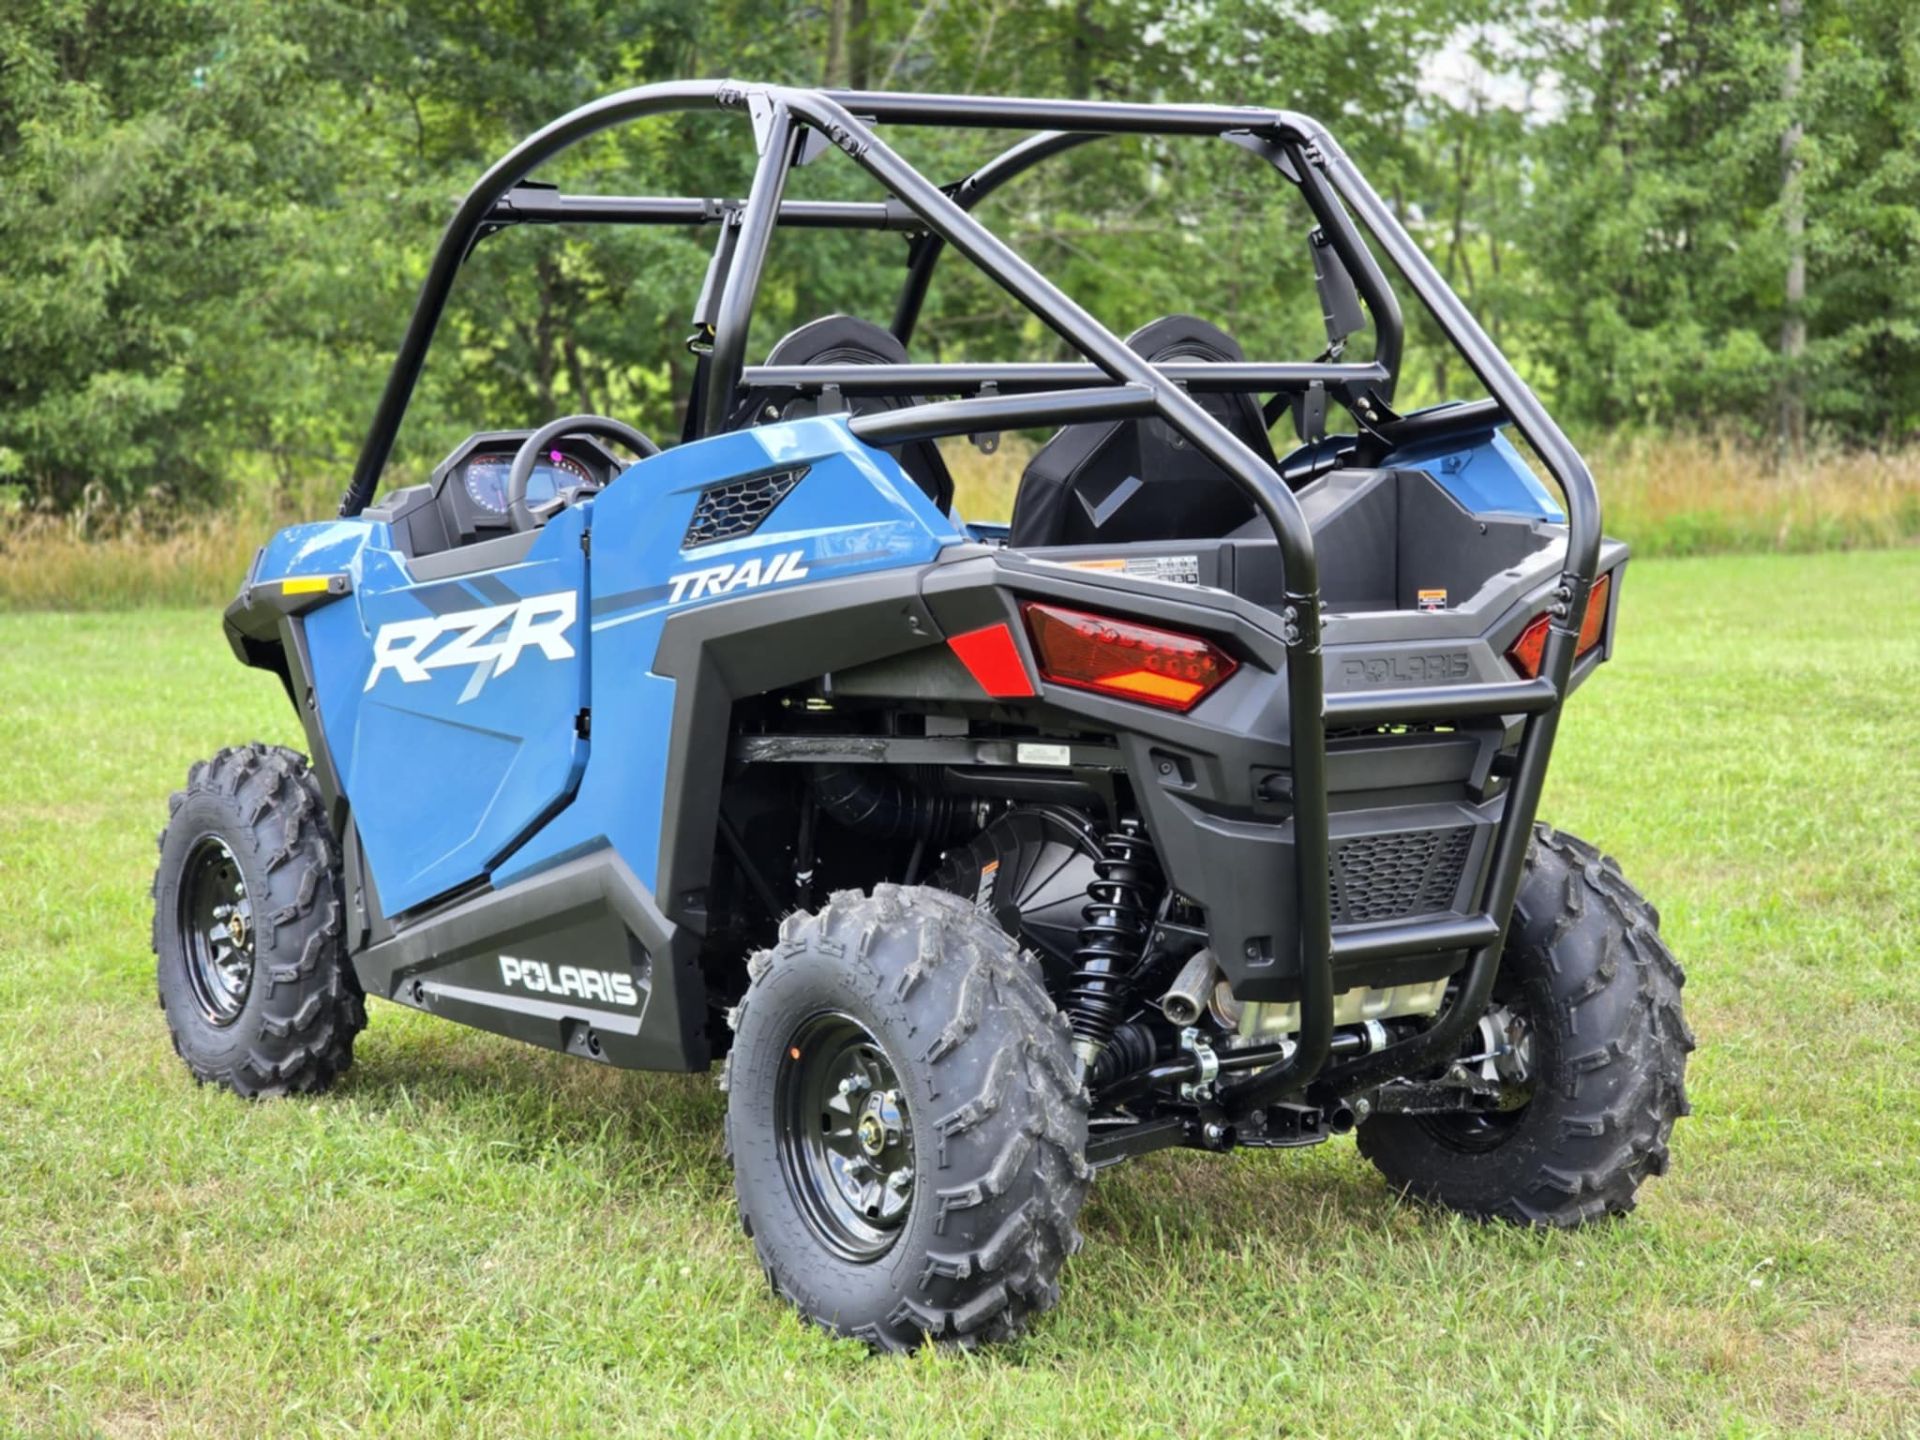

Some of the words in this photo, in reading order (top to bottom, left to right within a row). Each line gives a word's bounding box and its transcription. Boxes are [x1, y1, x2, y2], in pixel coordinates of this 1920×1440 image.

[667, 551, 809, 604] TRAIL
[363, 590, 577, 693] RZR
[1340, 653, 1471, 685] POLARIS
[498, 955, 638, 1006] POLARIS
